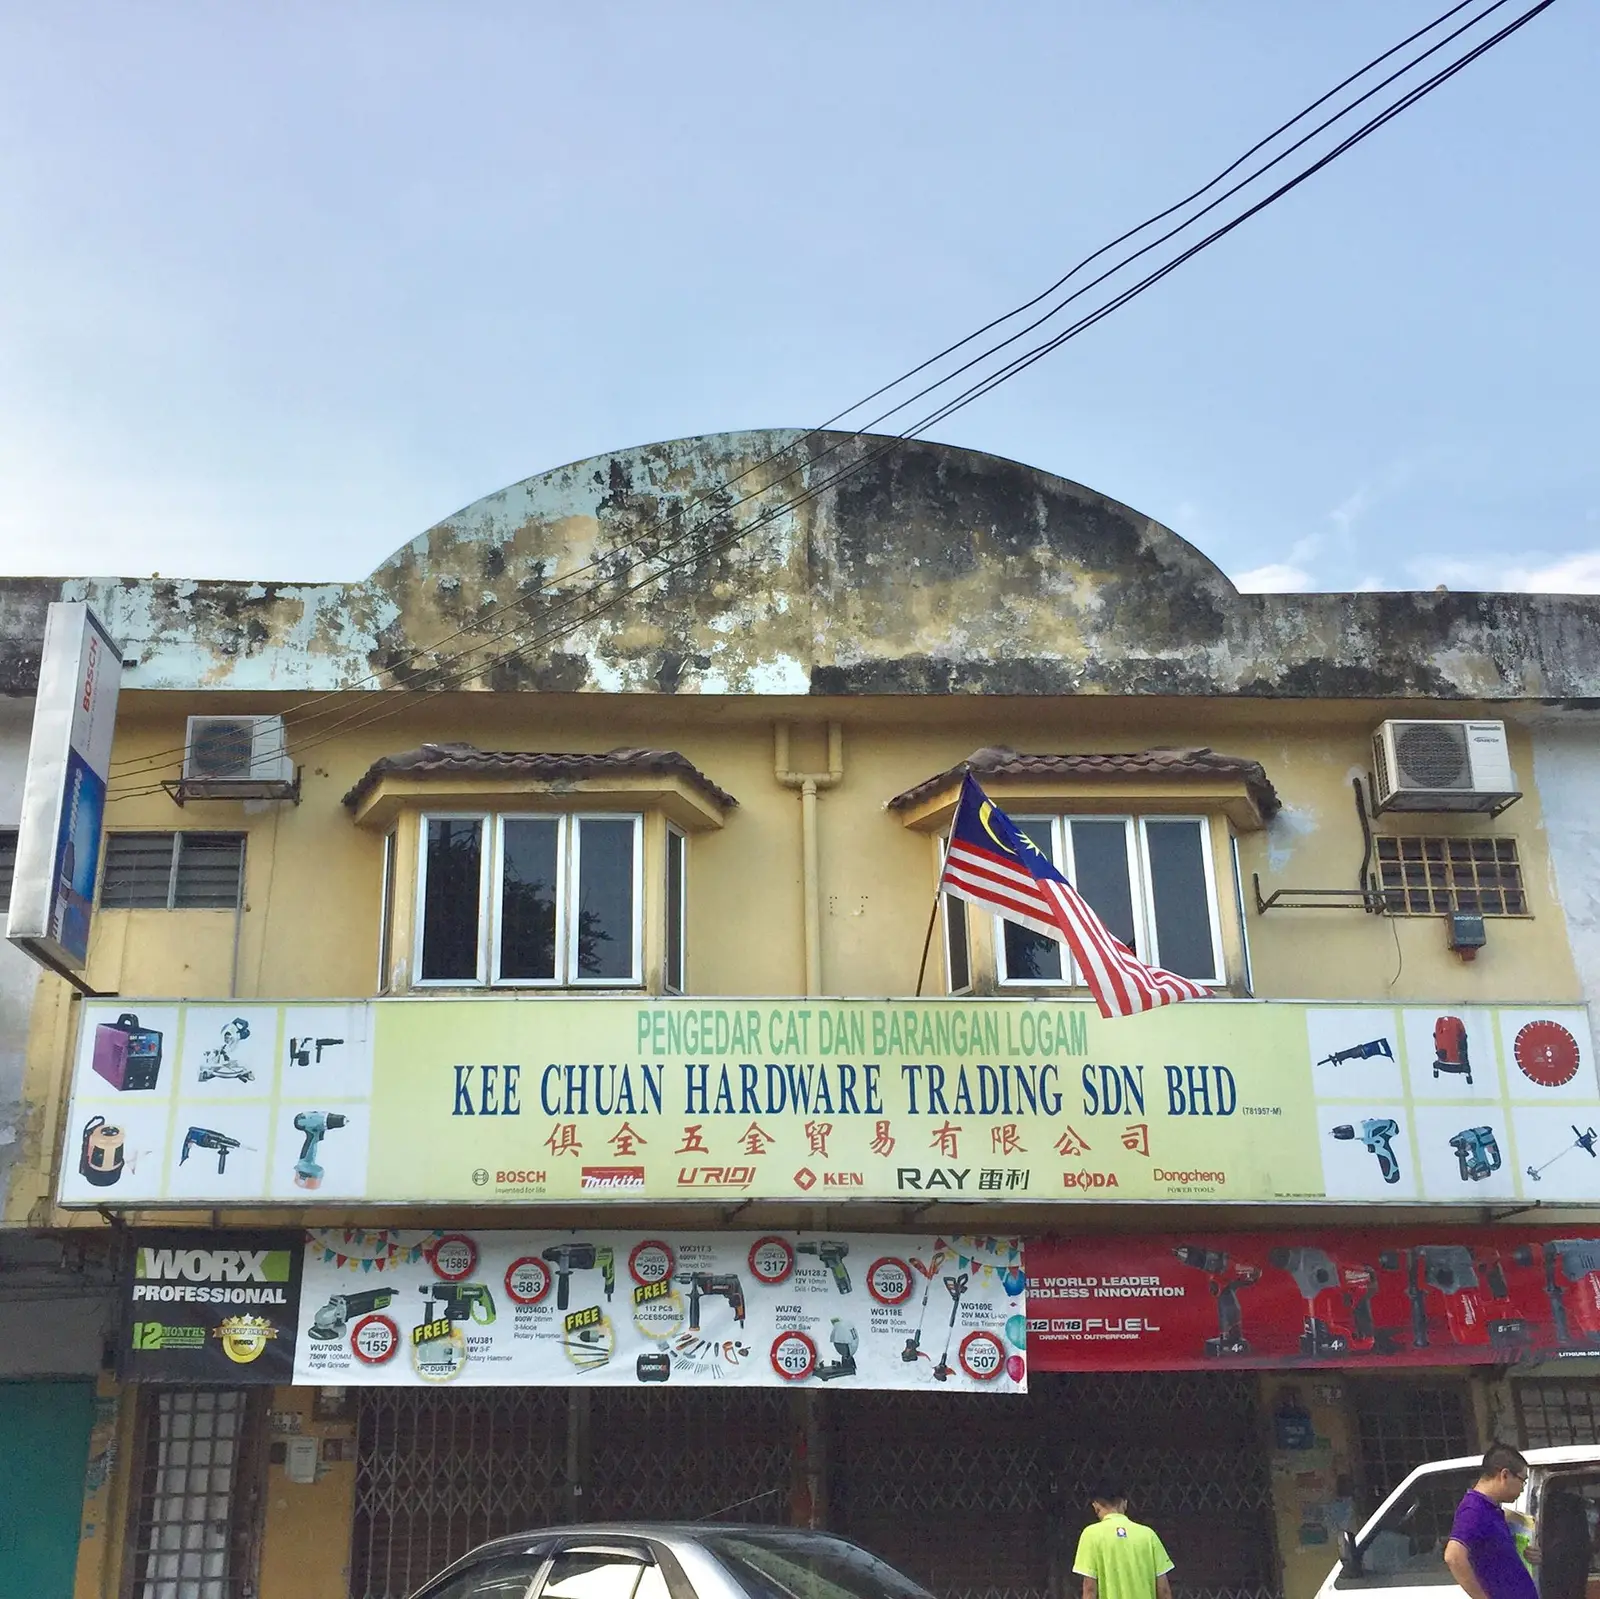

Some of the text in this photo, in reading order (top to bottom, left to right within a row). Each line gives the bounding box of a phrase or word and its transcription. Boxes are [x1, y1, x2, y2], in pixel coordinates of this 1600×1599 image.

[83, 637, 98, 712] BOSCH
[638, 1010, 1088, 1056] PENGEDAR CAT DAN BARANGAN LOGAM
[452, 1064, 1282, 1116] KEE CHUAN HARDWARE TRADING SDN BHD (781957-M)
[496, 1171, 546, 1183] BOSCH
[823, 1172, 864, 1185] KEN
[897, 1168, 1031, 1190] RAY 雷利
[1153, 1169, 1225, 1184] Dongcheng
[144, 1248, 268, 1282] WORX
[445, 1258, 469, 1269] 1589
[764, 1260, 786, 1272] 317
[642, 1264, 665, 1276] 295
[518, 1282, 541, 1293] 583
[881, 1282, 904, 1293] 308
[1043, 1278, 1097, 1287] WORLD
[1102, 1277, 1160, 1286] LEADER
[132, 1285, 287, 1305] PROFESSIONAL
[634, 1281, 668, 1303] FREE
[1094, 1287, 1185, 1297] INNOVATION
[566, 1308, 600, 1332] FREE
[1053, 1320, 1081, 1330] M18
[1086, 1318, 1160, 1331] FUEL
[132, 1322, 206, 1350] 12 MONTHS
[221, 1328, 270, 1336] LUCKY DRAW
[414, 1319, 450, 1343] FREE
[514, 1332, 533, 1340] Rotary
[310, 1344, 343, 1352] WU700S
[366, 1340, 388, 1351] 155
[466, 1354, 485, 1362] Rotary
[784, 1357, 807, 1368] 613
[973, 1356, 996, 1368] 507
